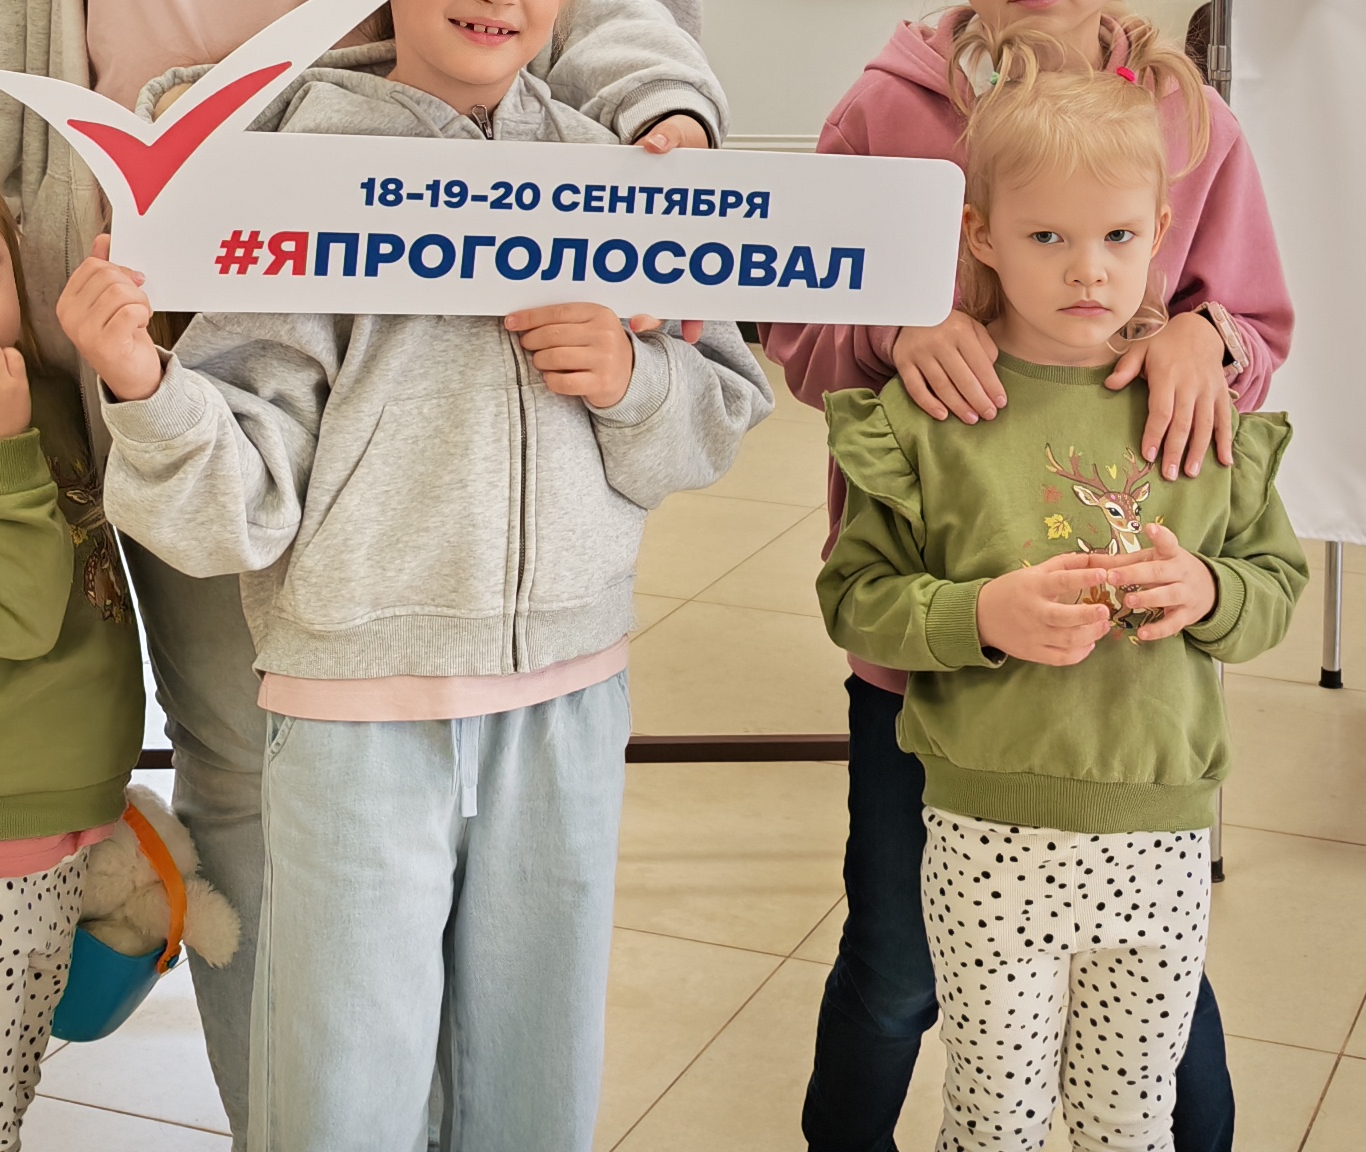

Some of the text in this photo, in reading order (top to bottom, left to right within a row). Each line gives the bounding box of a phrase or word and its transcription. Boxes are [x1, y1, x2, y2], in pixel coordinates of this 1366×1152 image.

[360, 177, 770, 219] 18-19-20 СЕНТЯБРЯ
[214, 229, 865, 290] #ЯПРОГОЛОСОВАЛ
